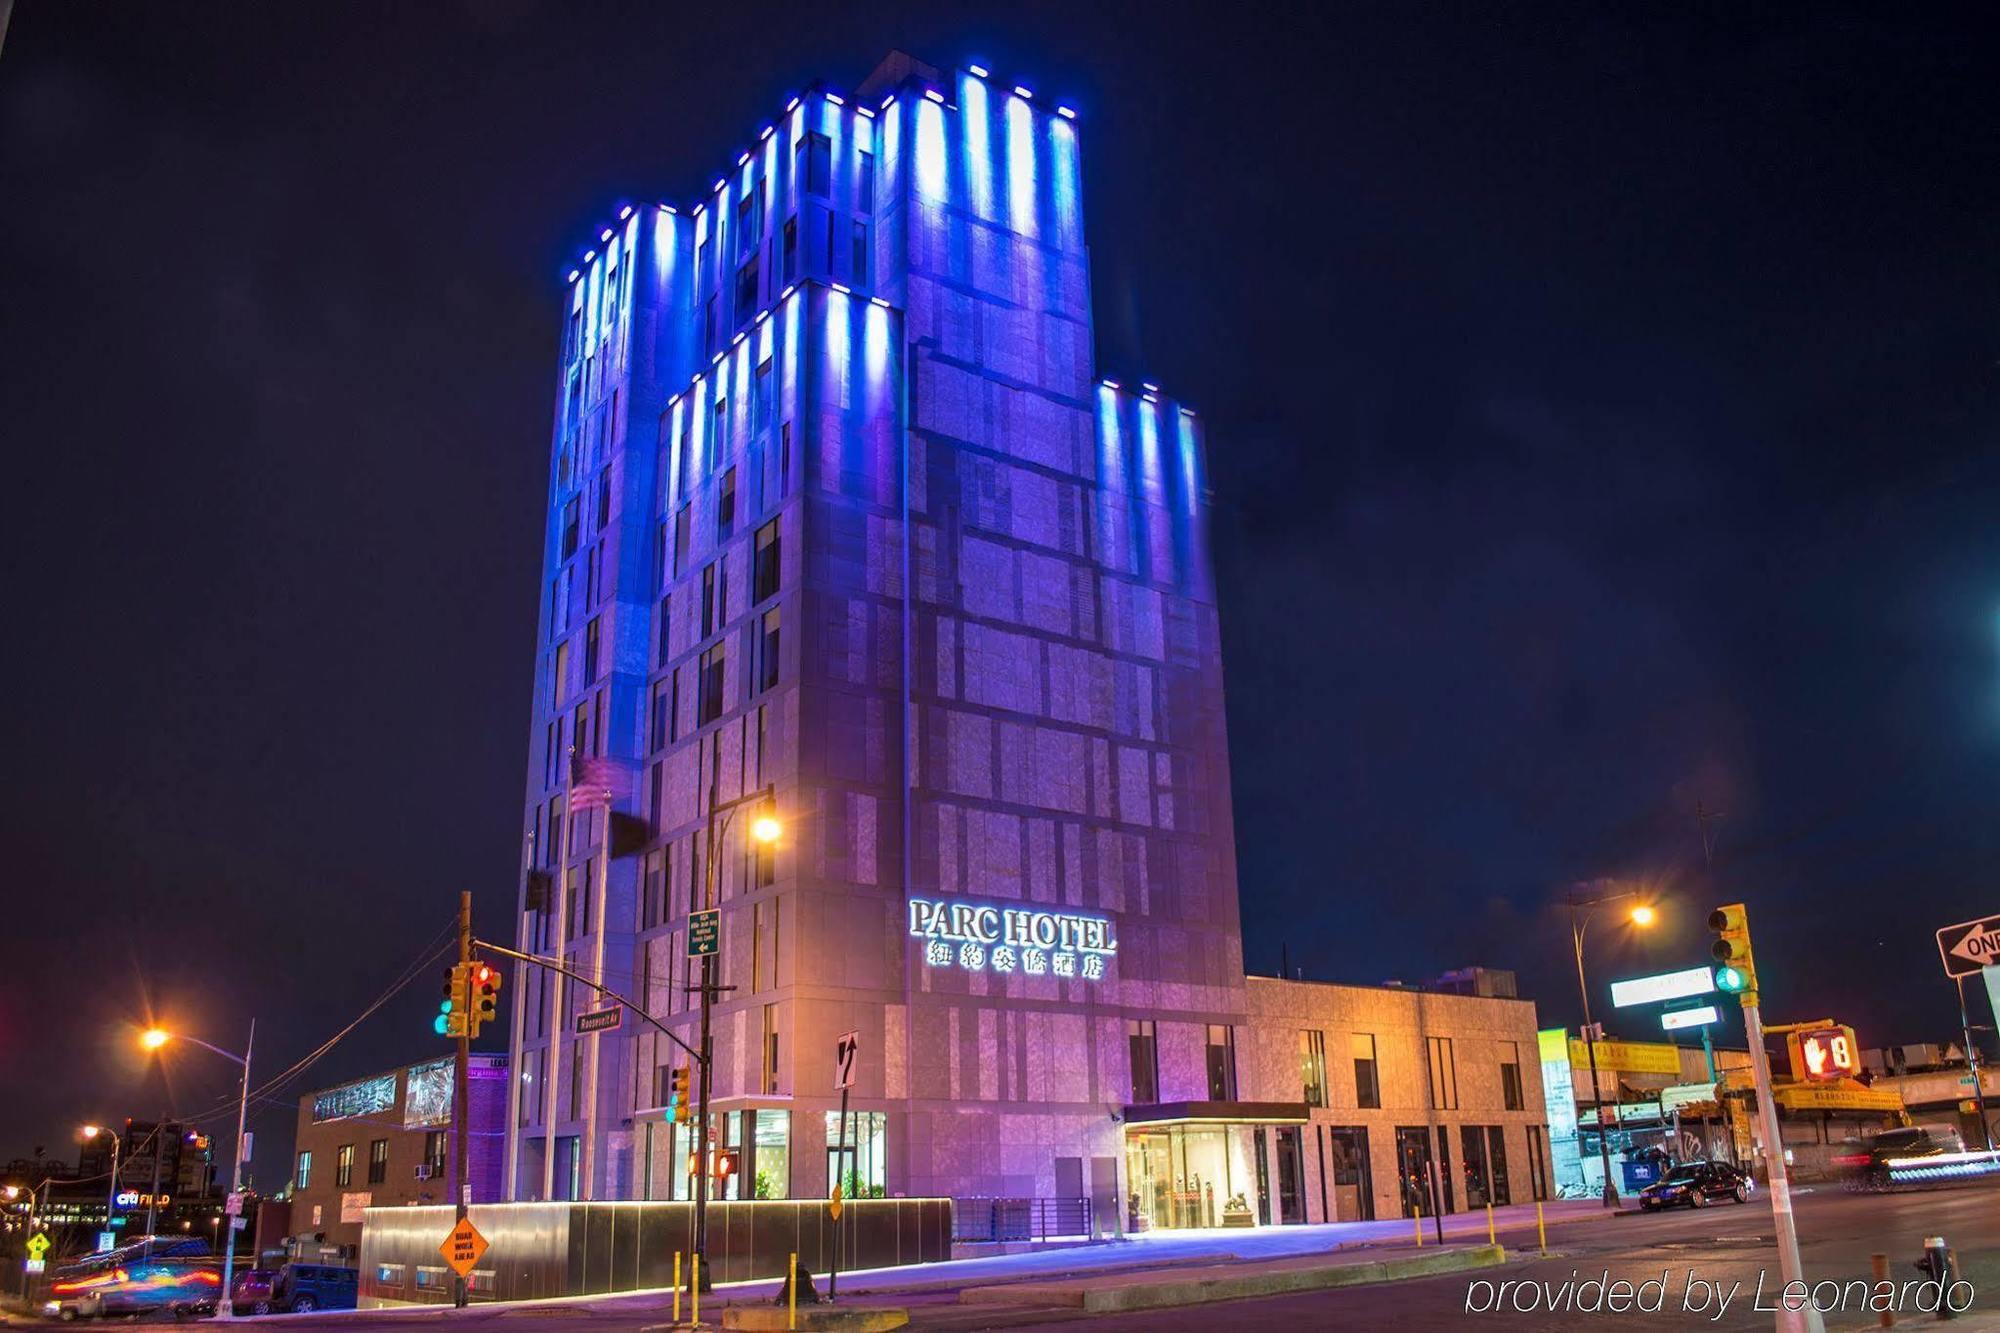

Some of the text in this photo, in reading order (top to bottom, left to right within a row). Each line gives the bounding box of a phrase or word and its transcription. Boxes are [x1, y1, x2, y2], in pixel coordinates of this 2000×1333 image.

[911, 900, 1117, 953] PARC HOTEL
[455, 1242, 473, 1250] WORK
